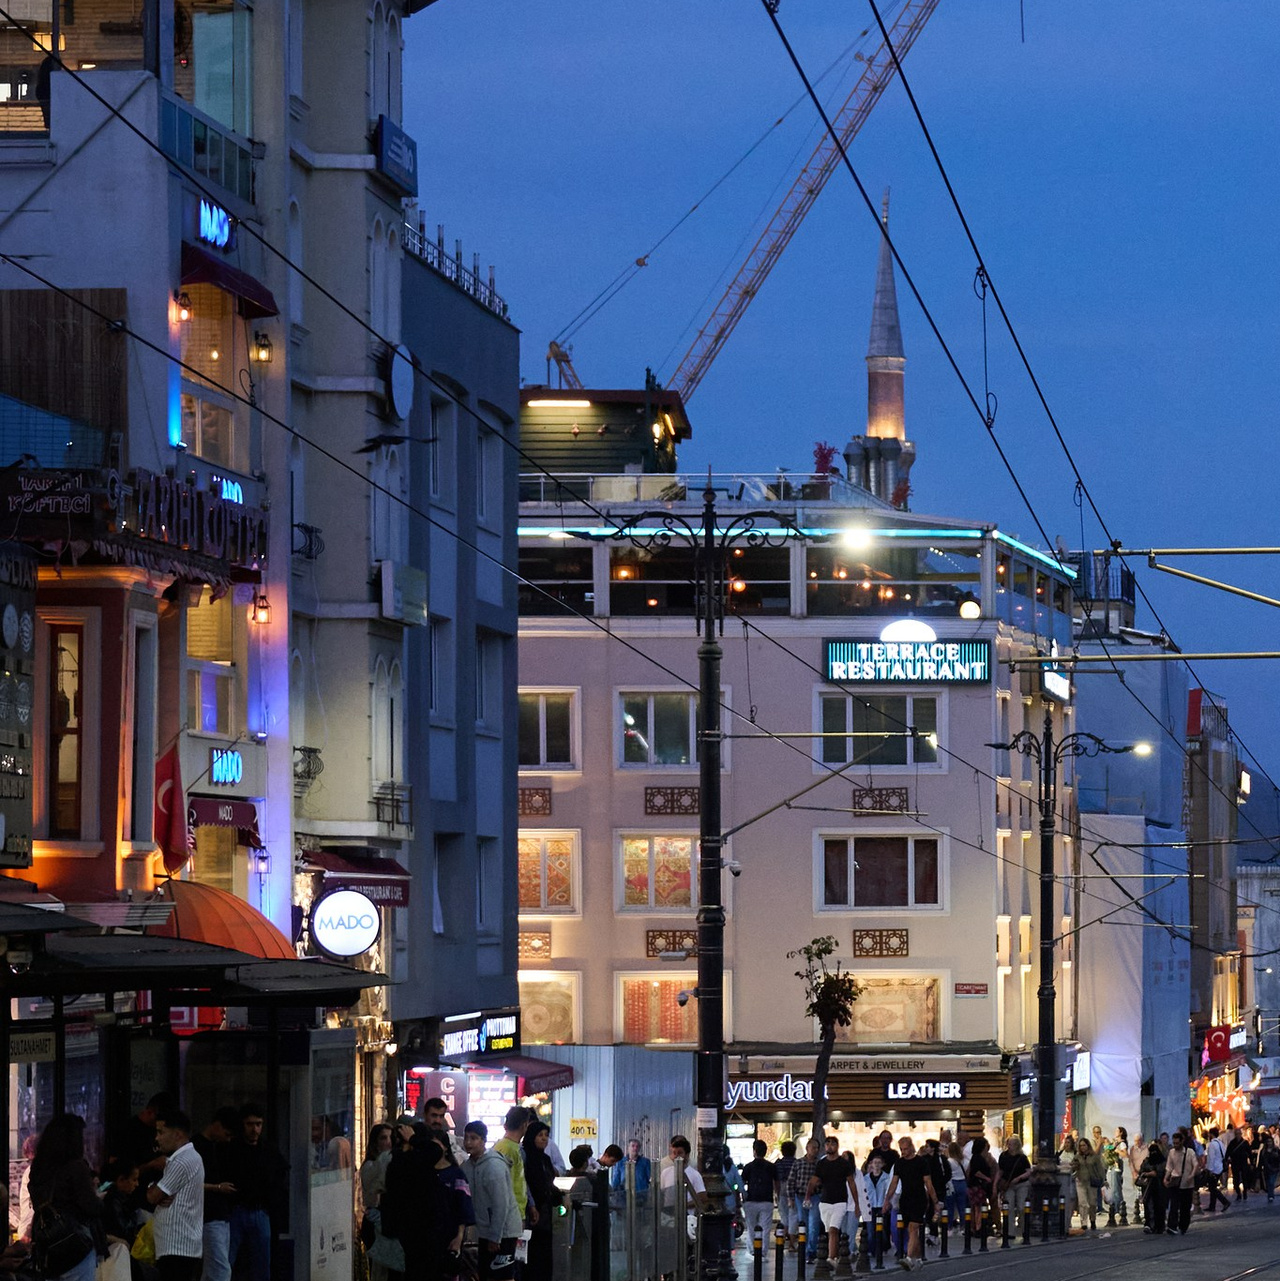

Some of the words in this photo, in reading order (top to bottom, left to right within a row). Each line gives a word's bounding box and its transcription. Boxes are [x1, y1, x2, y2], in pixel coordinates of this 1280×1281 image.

[858, 642, 960, 660] TERRACE
[832, 661, 985, 680] RESTAURANT
[213, 749, 243, 784] MADO
[318, 914, 374, 930] MADO
[830, 1061, 861, 1070] ARPET
[863, 1061, 869, 1070] &
[871, 1060, 926, 1070] JEWELLERY
[888, 1082, 962, 1099] LEATHER
[587, 1126, 597, 1135] TL
